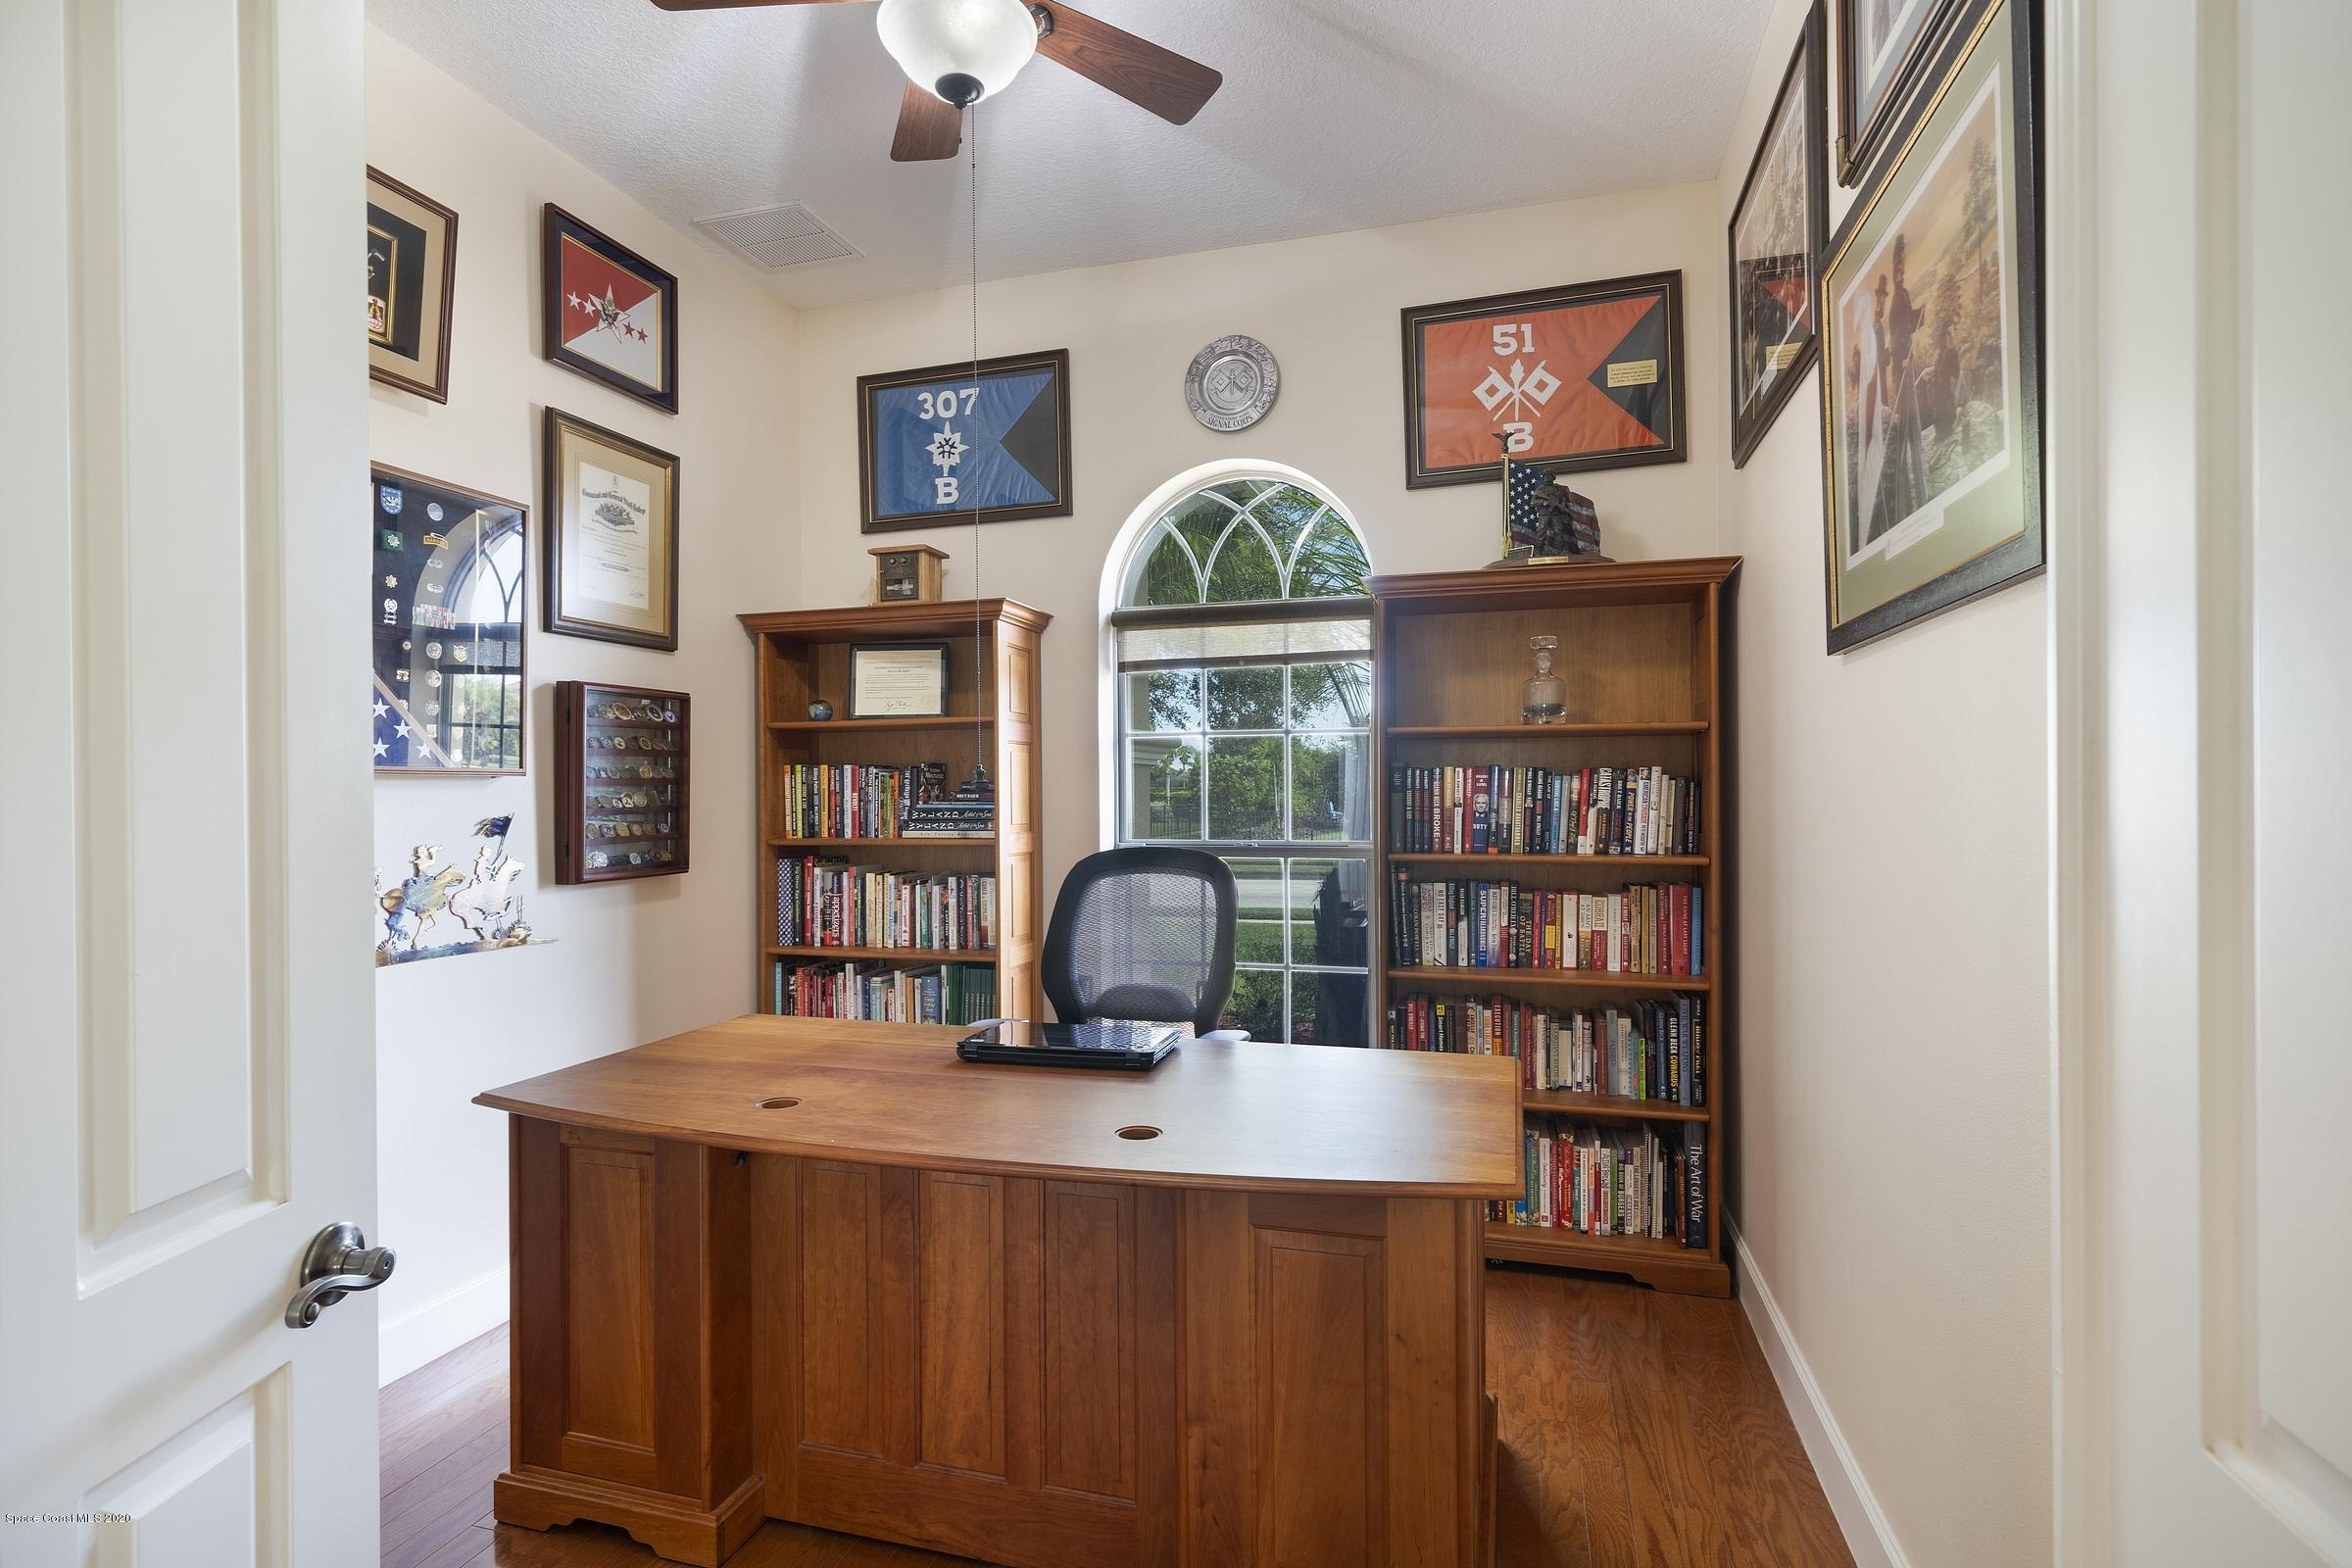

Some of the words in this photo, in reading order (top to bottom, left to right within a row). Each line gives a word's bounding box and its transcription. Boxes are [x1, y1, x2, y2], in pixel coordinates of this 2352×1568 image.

[1493, 323, 1535, 356] 51
[916, 387, 980, 420] 307
[1207, 416, 1232, 428] SIGNAL
[1233, 415, 1253, 428] CORPS
[1502, 421, 1535, 453] B
[935, 476, 959, 505] B
[1597, 768, 1613, 810] CATASTROPHE
[1627, 792, 1636, 812] POWER
[912, 809, 959, 819] WYLAND
[909, 821, 954, 831] WYLAND
[831, 896, 842, 938] appetizers
[1594, 900, 1605, 920] COBRA
[1520, 915, 1526, 927] OF
[1690, 1144, 1702, 1165] The
[1690, 1166, 1702, 1186] Art
[1690, 1186, 1703, 1198] of
[1690, 1200, 1703, 1224] War
